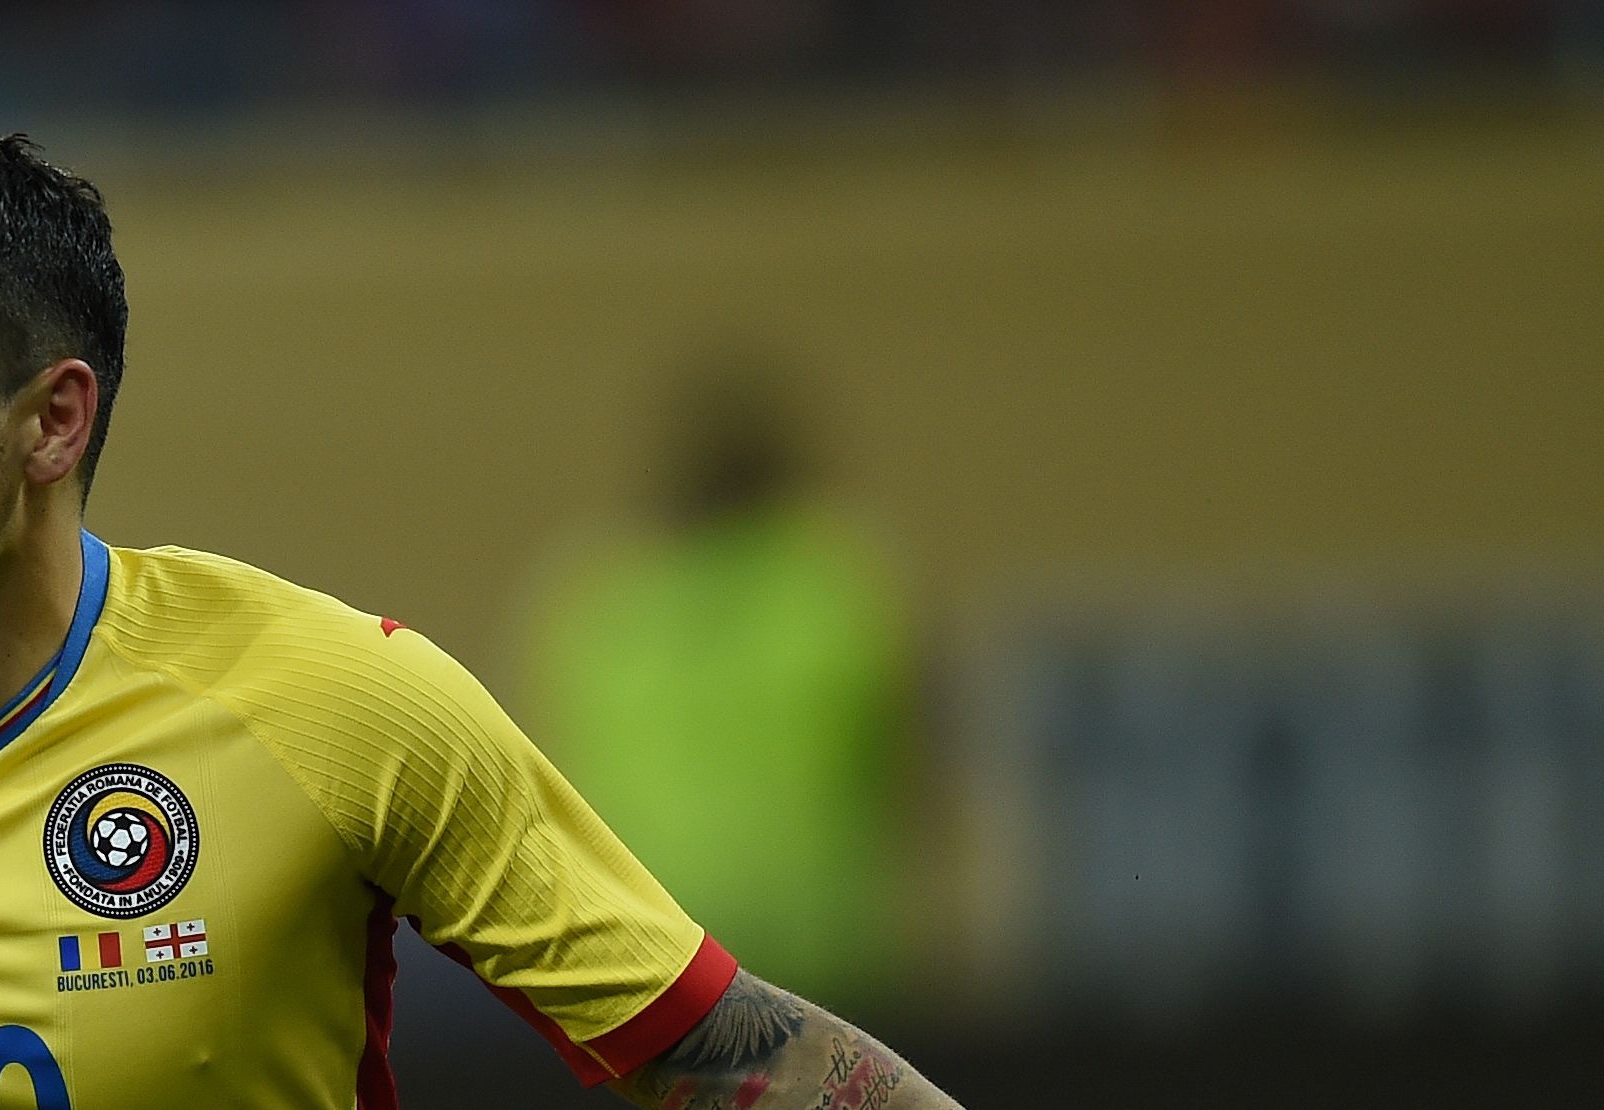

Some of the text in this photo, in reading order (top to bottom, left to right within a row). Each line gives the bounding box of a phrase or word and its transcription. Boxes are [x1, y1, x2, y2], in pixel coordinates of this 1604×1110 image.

[56, 775, 188, 857] FEDERATIA ROMANA DE FOTBAL
[63, 854, 185, 908] FONDATA IN ANUL 1909
[57, 958, 214, 992] BUCURESTI, 03.06.2016
[823, 1037, 862, 1085] the
